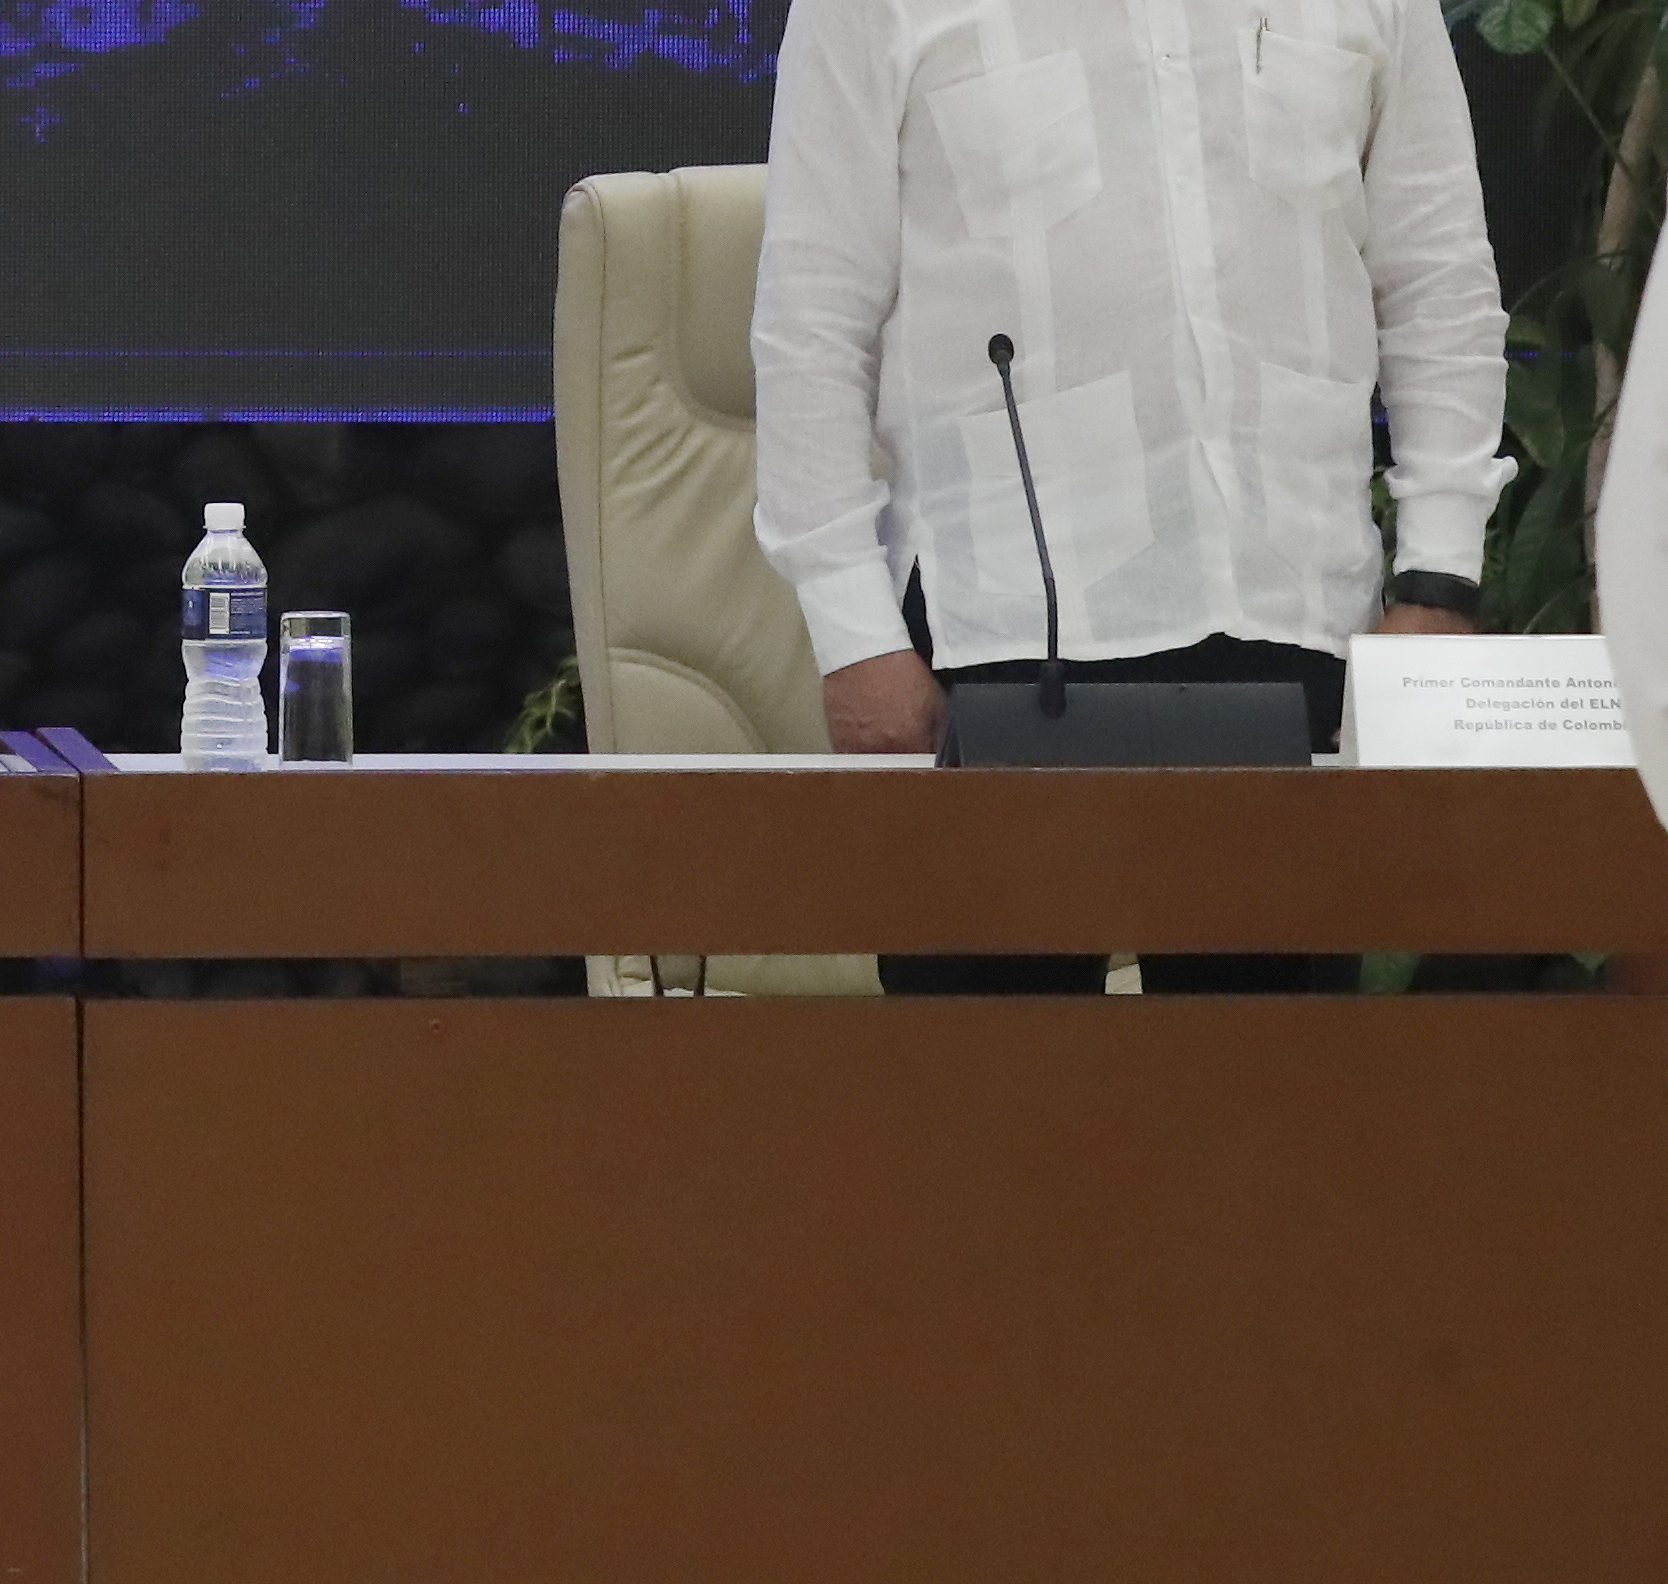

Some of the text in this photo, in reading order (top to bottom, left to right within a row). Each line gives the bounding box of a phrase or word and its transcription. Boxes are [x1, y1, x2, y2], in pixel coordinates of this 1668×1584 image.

[1402, 677, 1454, 688] Primer
[1461, 677, 1560, 688] Comandante
[1466, 698, 1554, 711] Delegación
[1560, 698, 1584, 710] del
[1454, 719, 1533, 732] República
[1538, 719, 1557, 730] de
